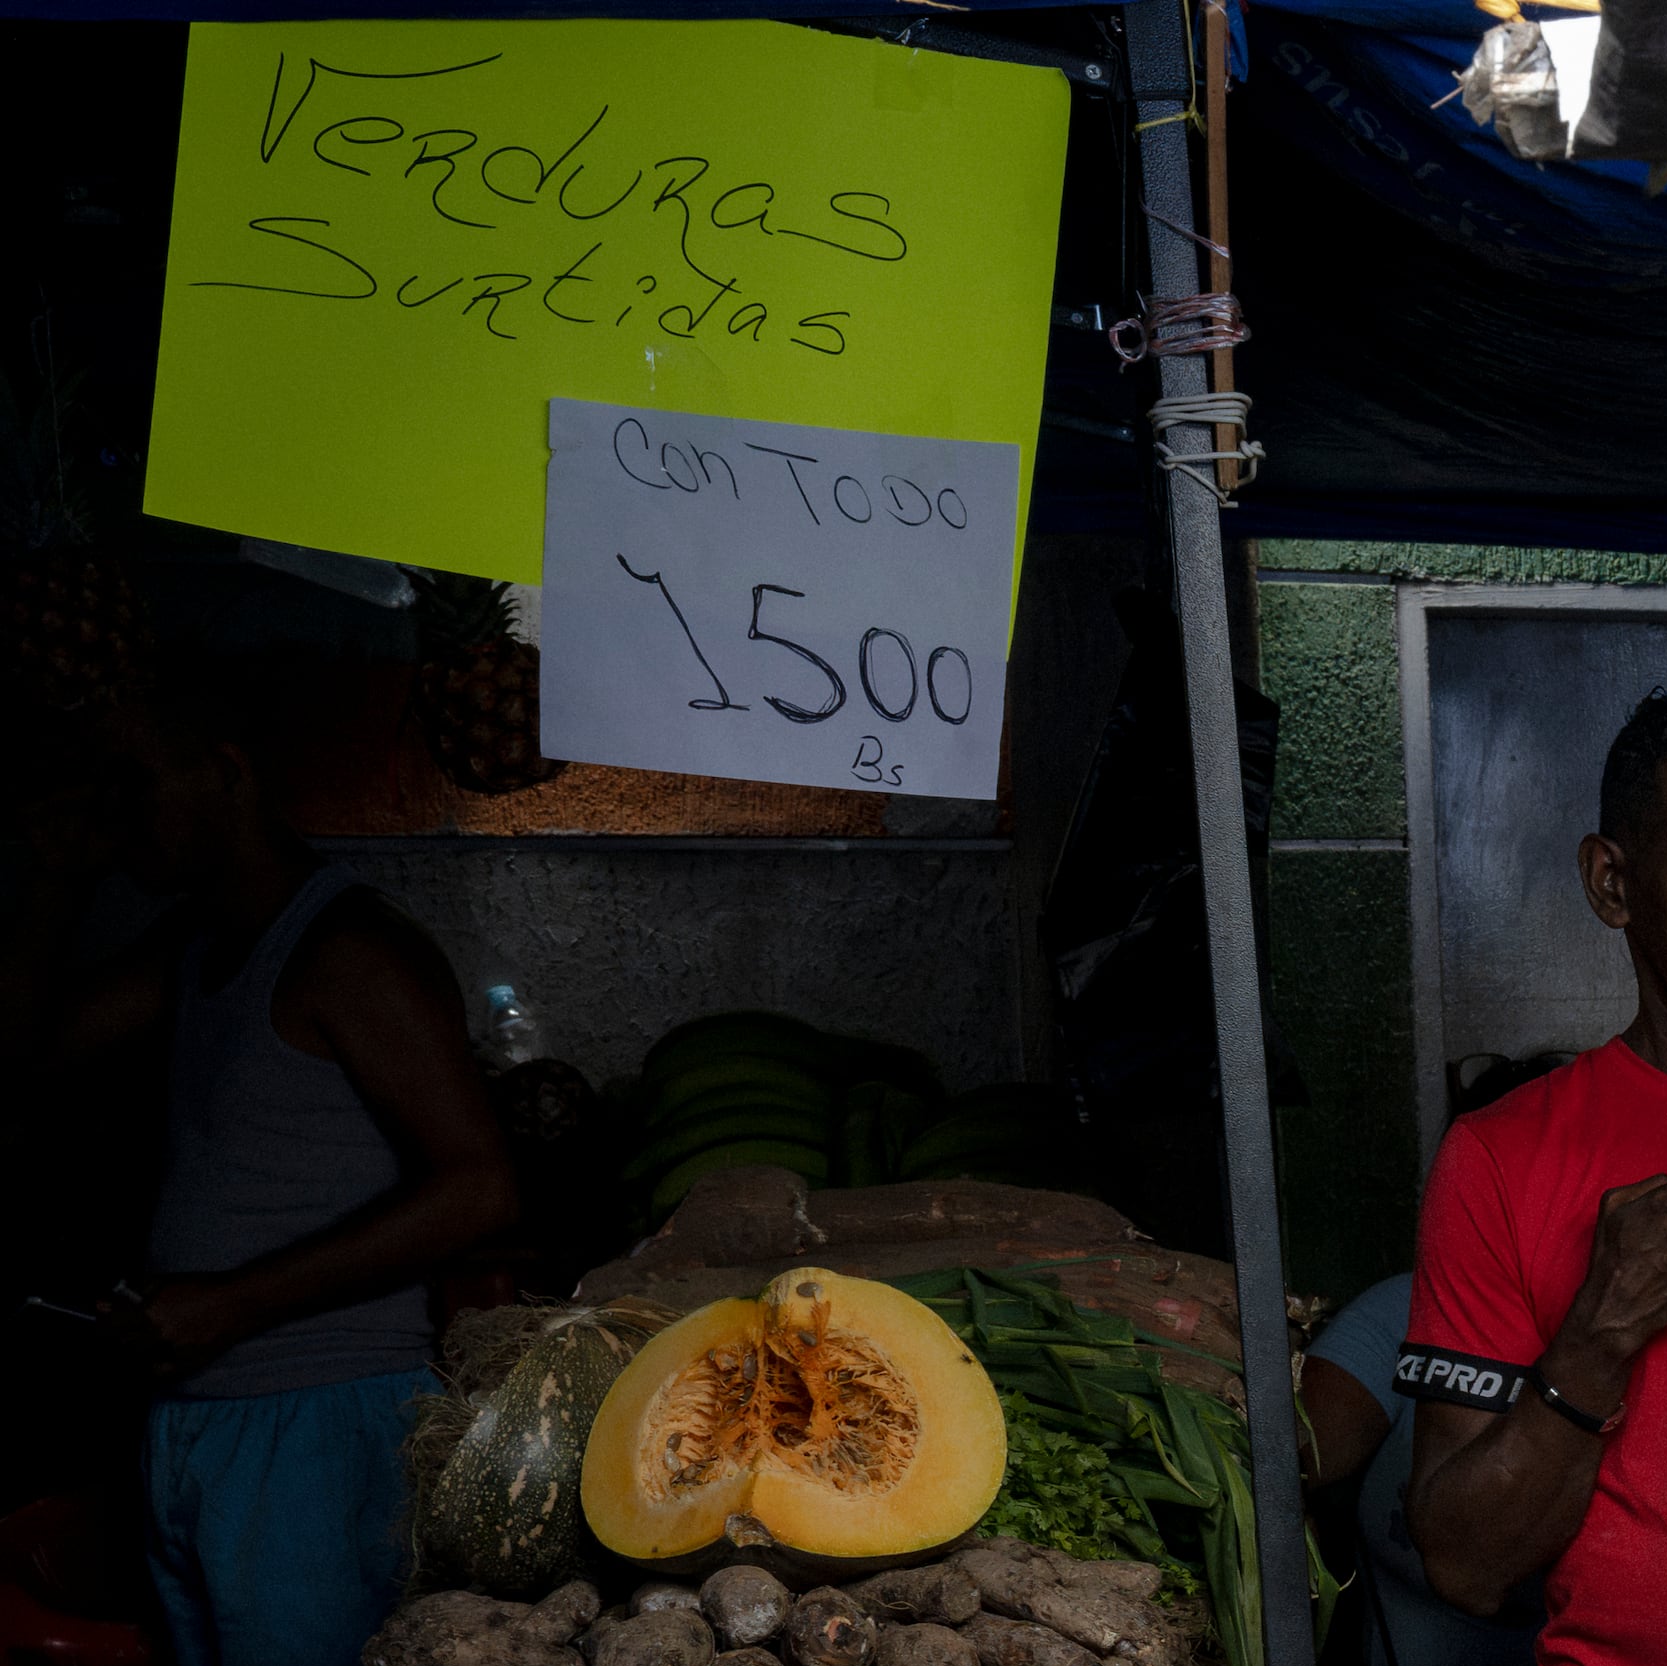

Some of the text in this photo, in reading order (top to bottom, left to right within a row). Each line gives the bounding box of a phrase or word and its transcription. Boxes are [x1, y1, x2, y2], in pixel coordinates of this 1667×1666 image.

[617, 553, 972, 726] 1500
[851, 736, 904, 788] Bs
[1423, 1358, 1504, 1399] PRO
